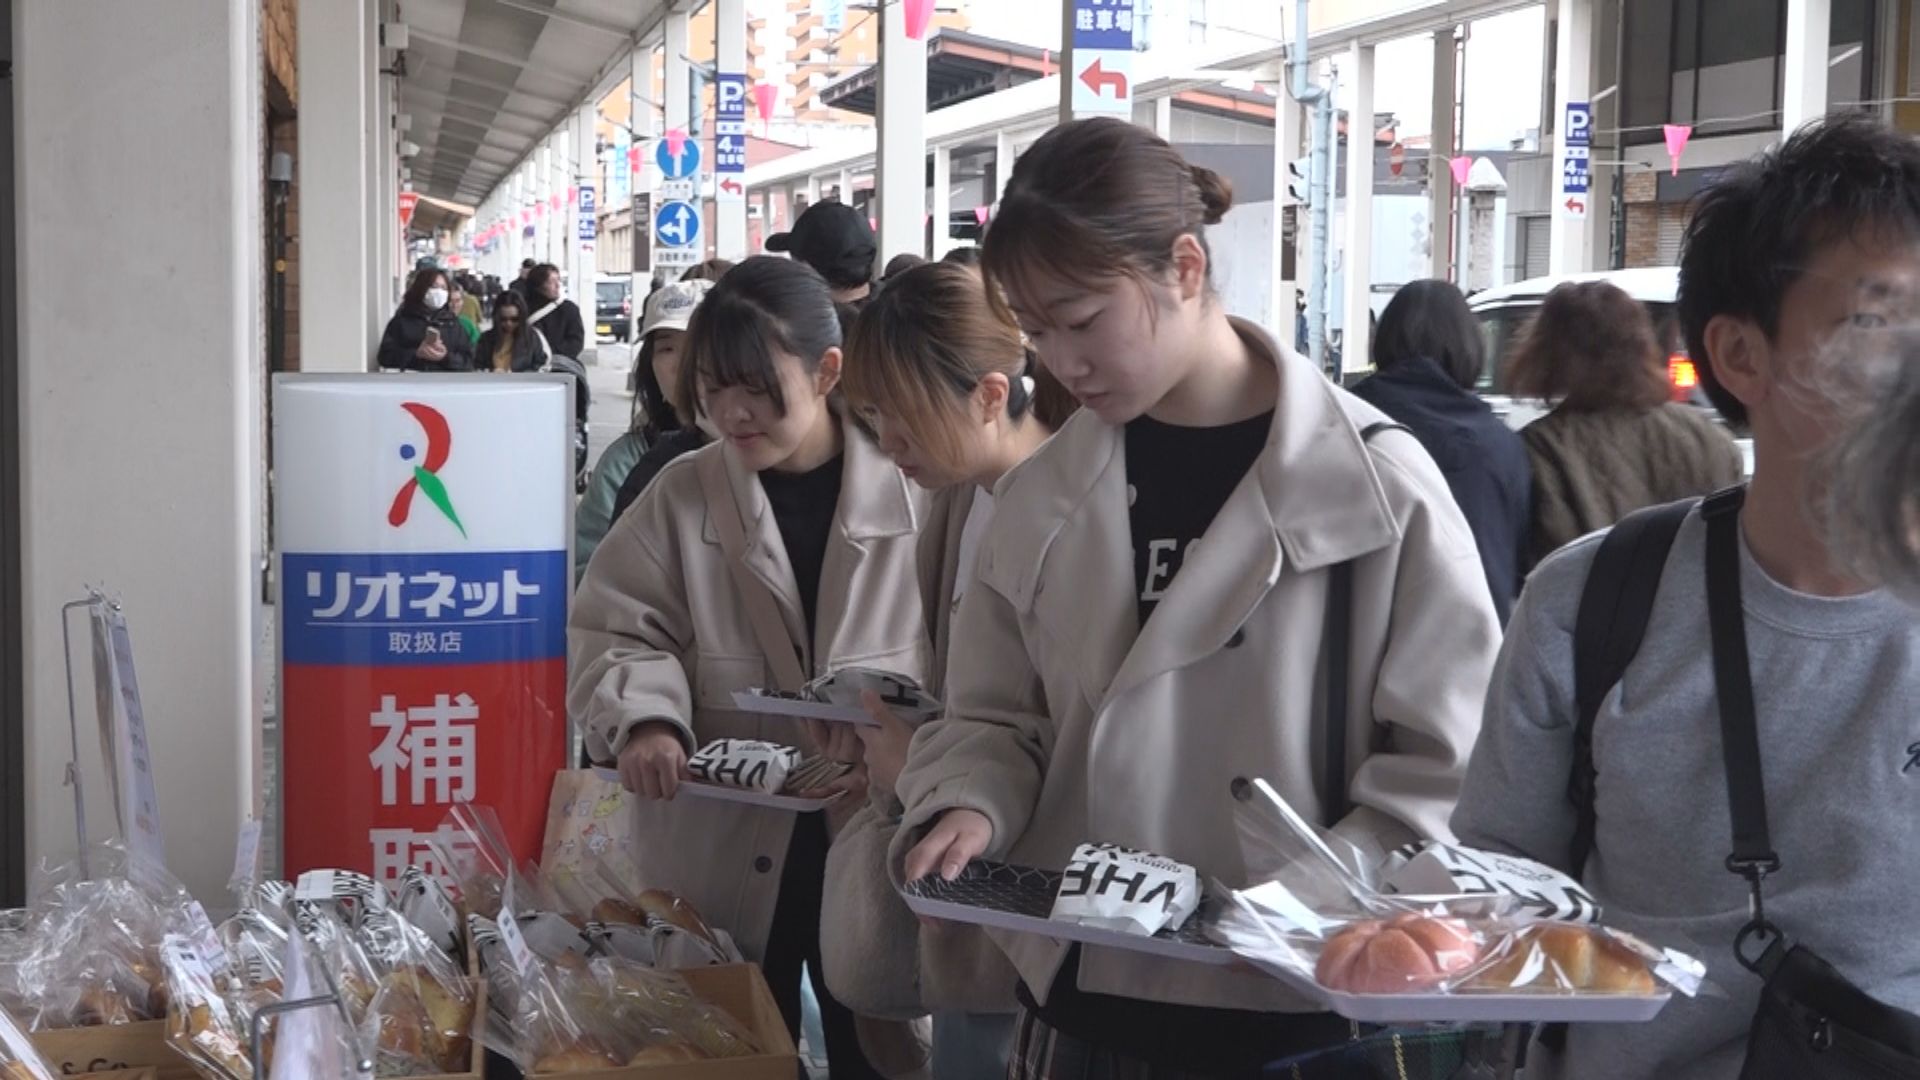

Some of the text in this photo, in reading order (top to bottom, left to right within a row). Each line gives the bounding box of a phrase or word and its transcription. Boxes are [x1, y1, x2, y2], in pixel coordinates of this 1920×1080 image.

[1076, 8, 1132, 32] 駐車場
[719, 79, 744, 112] P
[1567, 109, 1589, 137] P
[580, 190, 594, 207] P
[306, 569, 540, 619] リオネット
[388, 631, 463, 654] 取扱店
